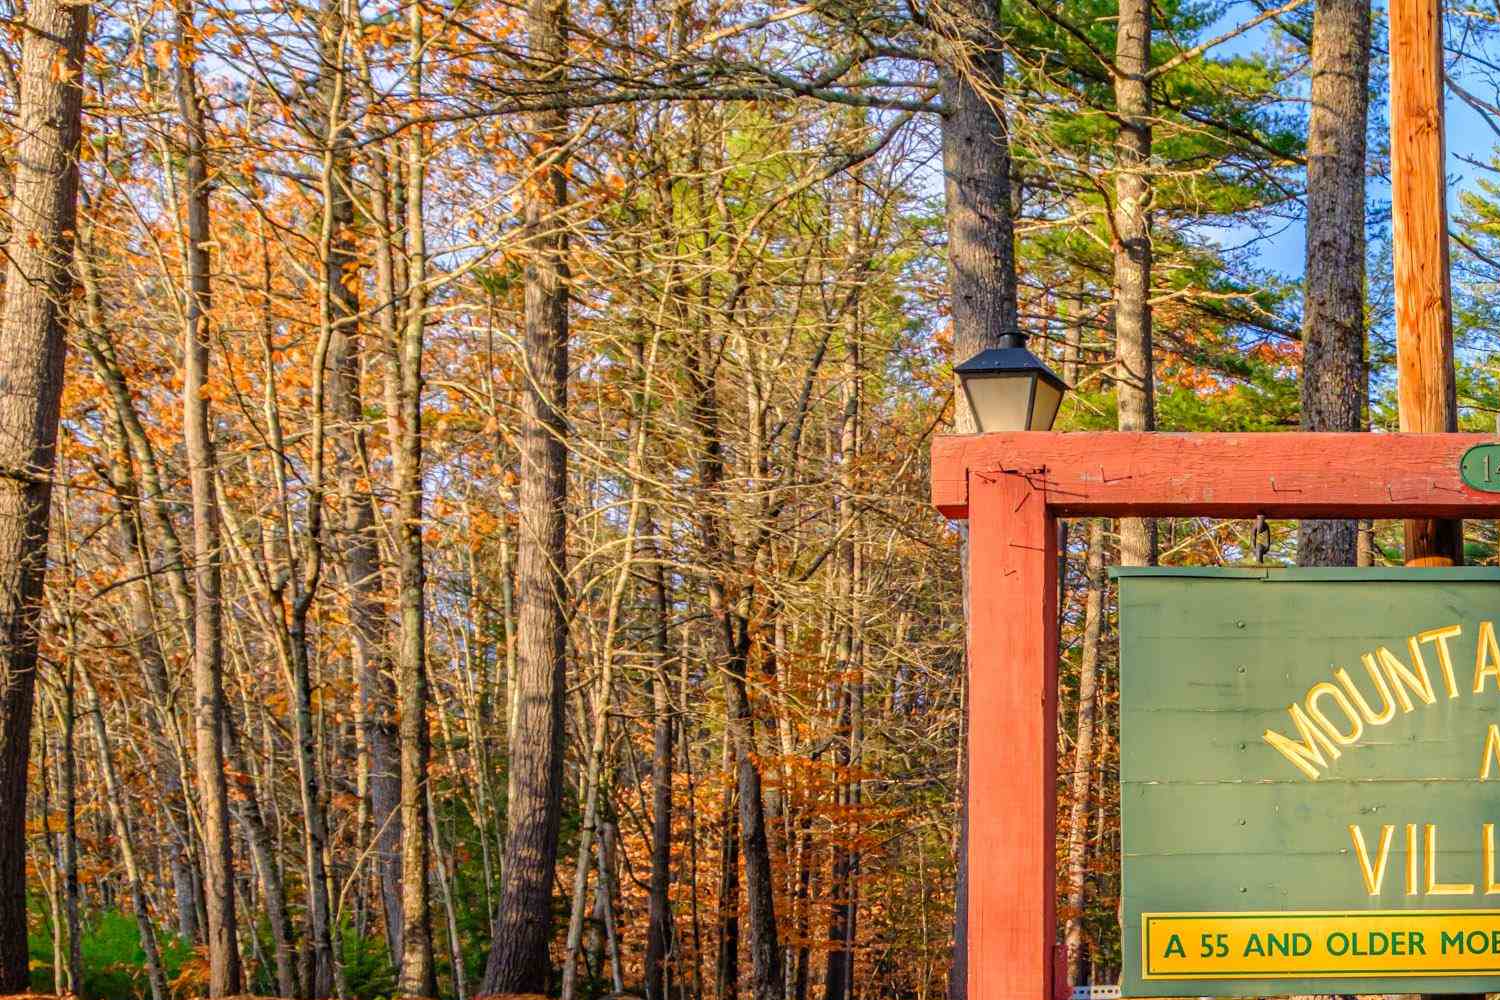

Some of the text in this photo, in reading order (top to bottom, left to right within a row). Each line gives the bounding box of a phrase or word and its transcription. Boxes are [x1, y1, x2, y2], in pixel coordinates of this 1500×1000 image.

[1163, 933, 1187, 958] A
[1200, 933, 1230, 958] 55
[1242, 932, 1313, 957] AND
[1326, 930, 1427, 956] OLDER
